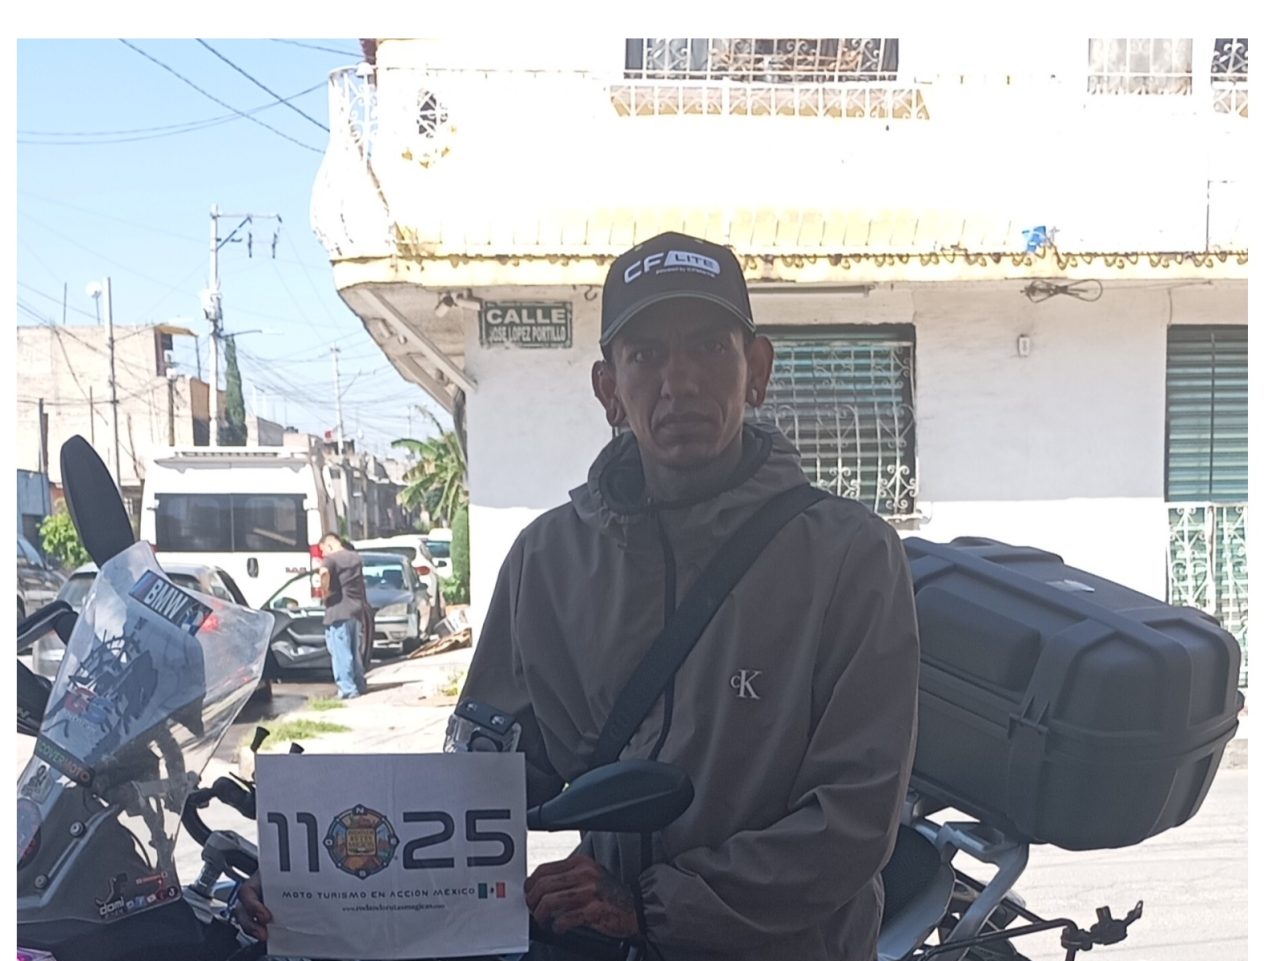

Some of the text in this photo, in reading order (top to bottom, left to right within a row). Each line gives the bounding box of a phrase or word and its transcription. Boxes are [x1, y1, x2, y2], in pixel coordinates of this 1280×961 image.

[674, 252, 715, 270] LITE
[486, 308, 566, 325] CALLE
[532, 326, 567, 342] PORTILLO
[144, 580, 189, 619] BMW
[282, 891, 313, 900] MOTO
[317, 891, 367, 900] TURISMO
[370, 891, 386, 899] EN
